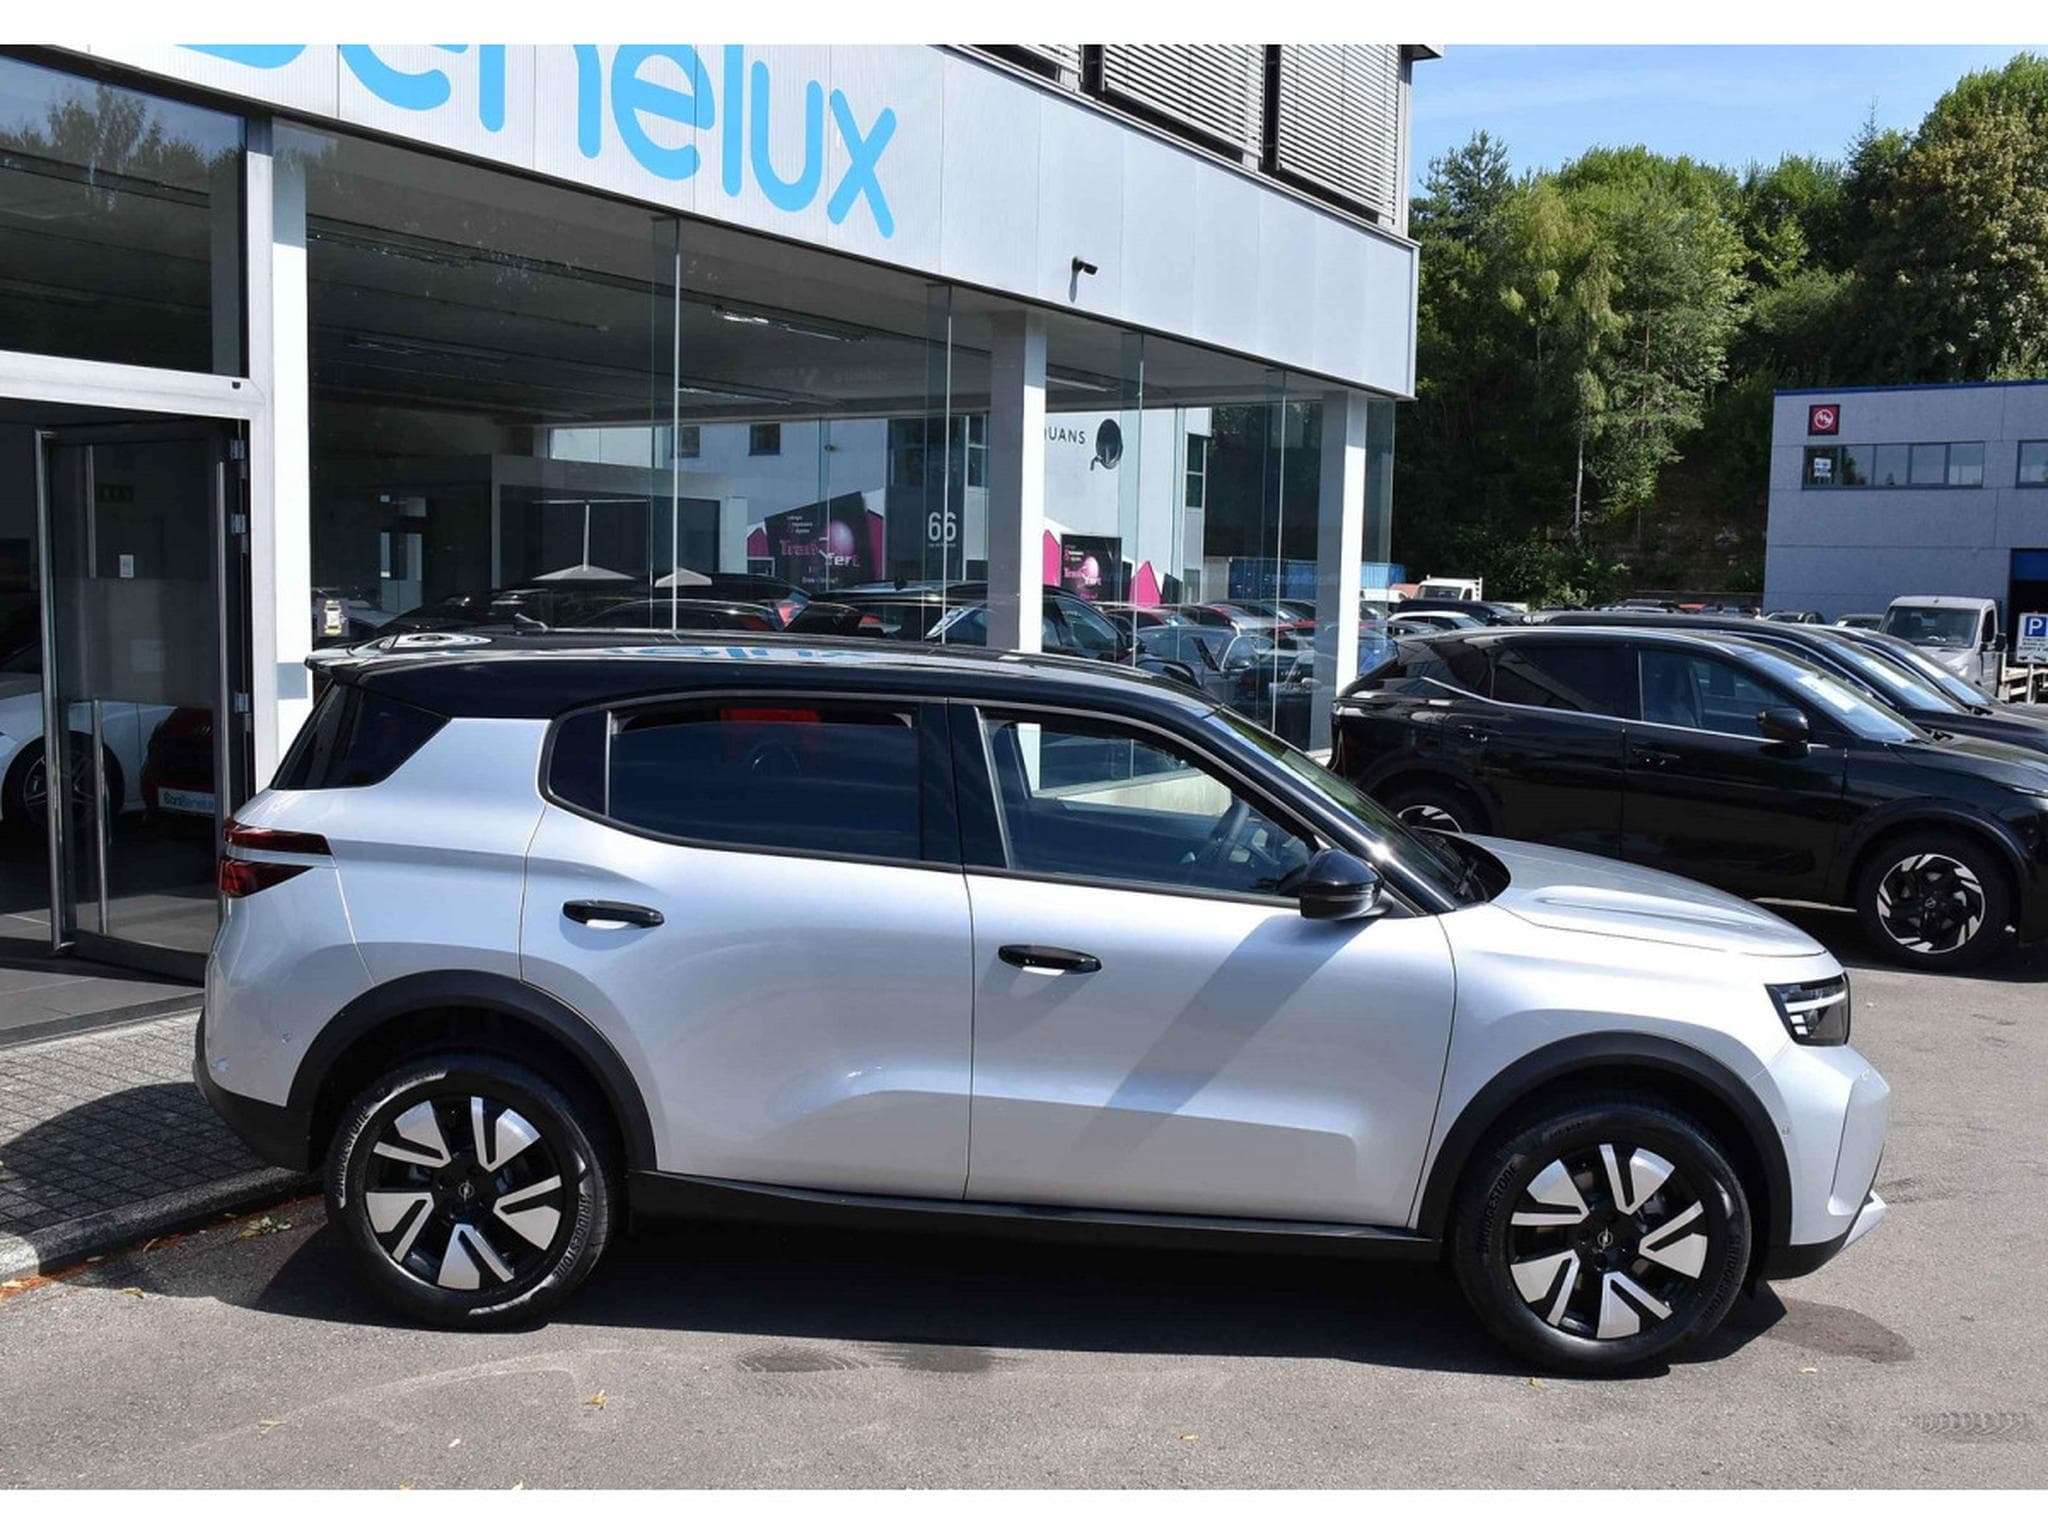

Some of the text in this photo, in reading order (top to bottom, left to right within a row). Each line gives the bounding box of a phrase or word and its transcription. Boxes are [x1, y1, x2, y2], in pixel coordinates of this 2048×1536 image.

[174, 45, 897, 238] nelux
[1044, 427, 1086, 445] UANS
[928, 511, 957, 542] 66
[2028, 617, 2043, 636] P
